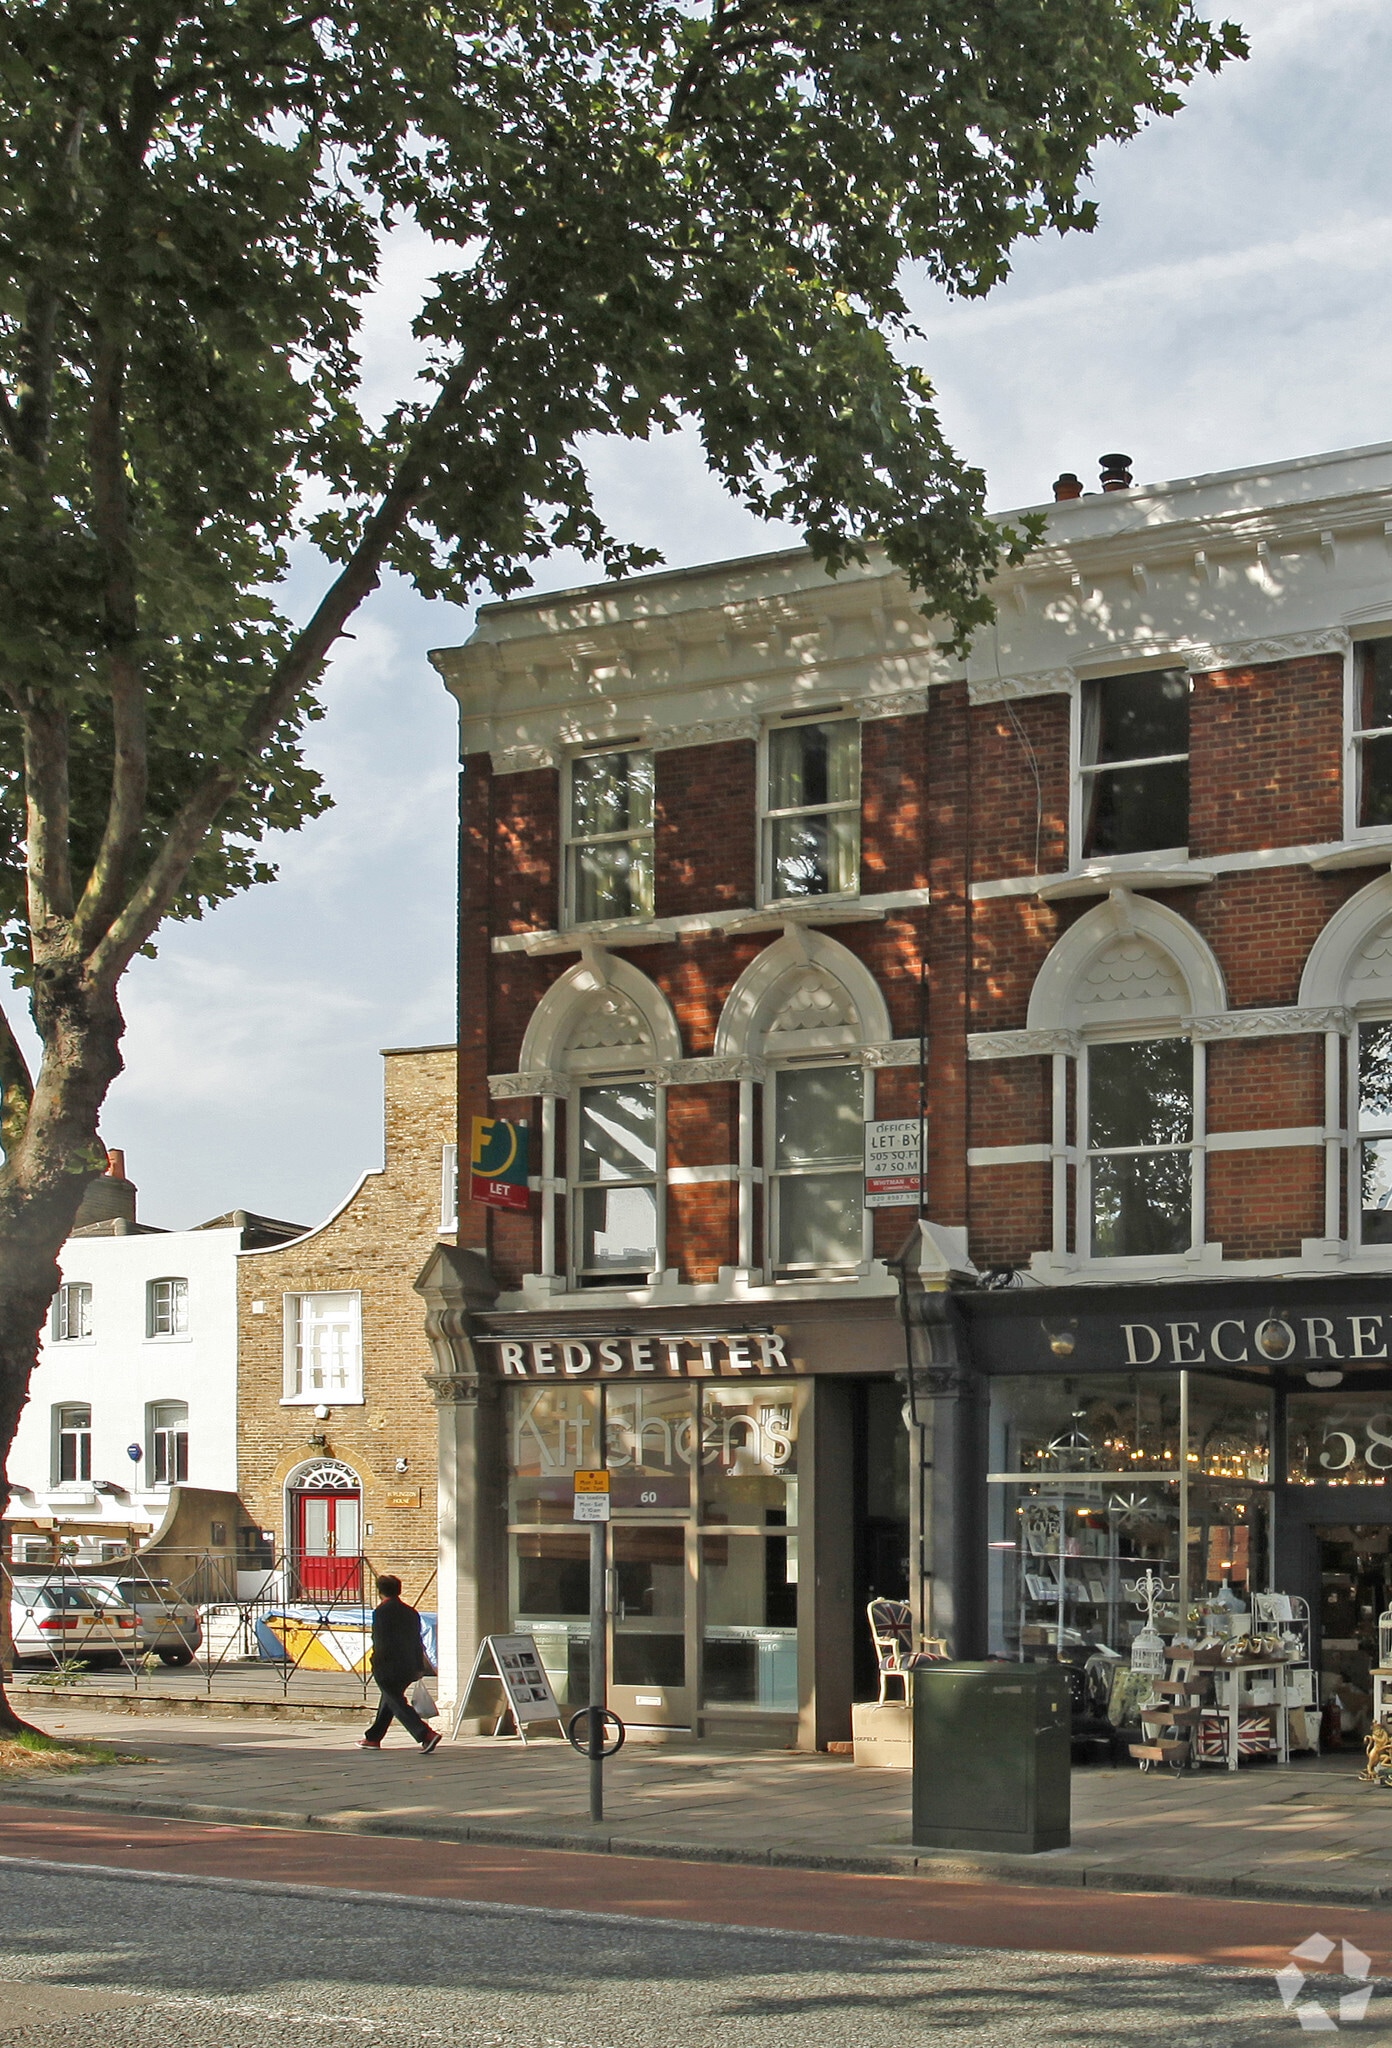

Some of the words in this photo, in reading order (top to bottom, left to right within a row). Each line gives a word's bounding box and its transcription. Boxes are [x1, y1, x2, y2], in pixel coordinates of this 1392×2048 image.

[876, 1123, 917, 1133] OFFICES
[872, 1136, 895, 1148] LET
[902, 1134, 920, 1146] BY
[870, 1152, 888, 1161] 505
[875, 1164, 887, 1172] 47
[873, 1178, 904, 1186] WHITMAN
[490, 1183, 510, 1196] LET
[1120, 1315, 1392, 1365] DECORE
[501, 1335, 788, 1375] REDSETTER
[513, 1387, 792, 1467] Kitchens
[1319, 1412, 1392, 1470] 58
[640, 1491, 657, 1503] 60
